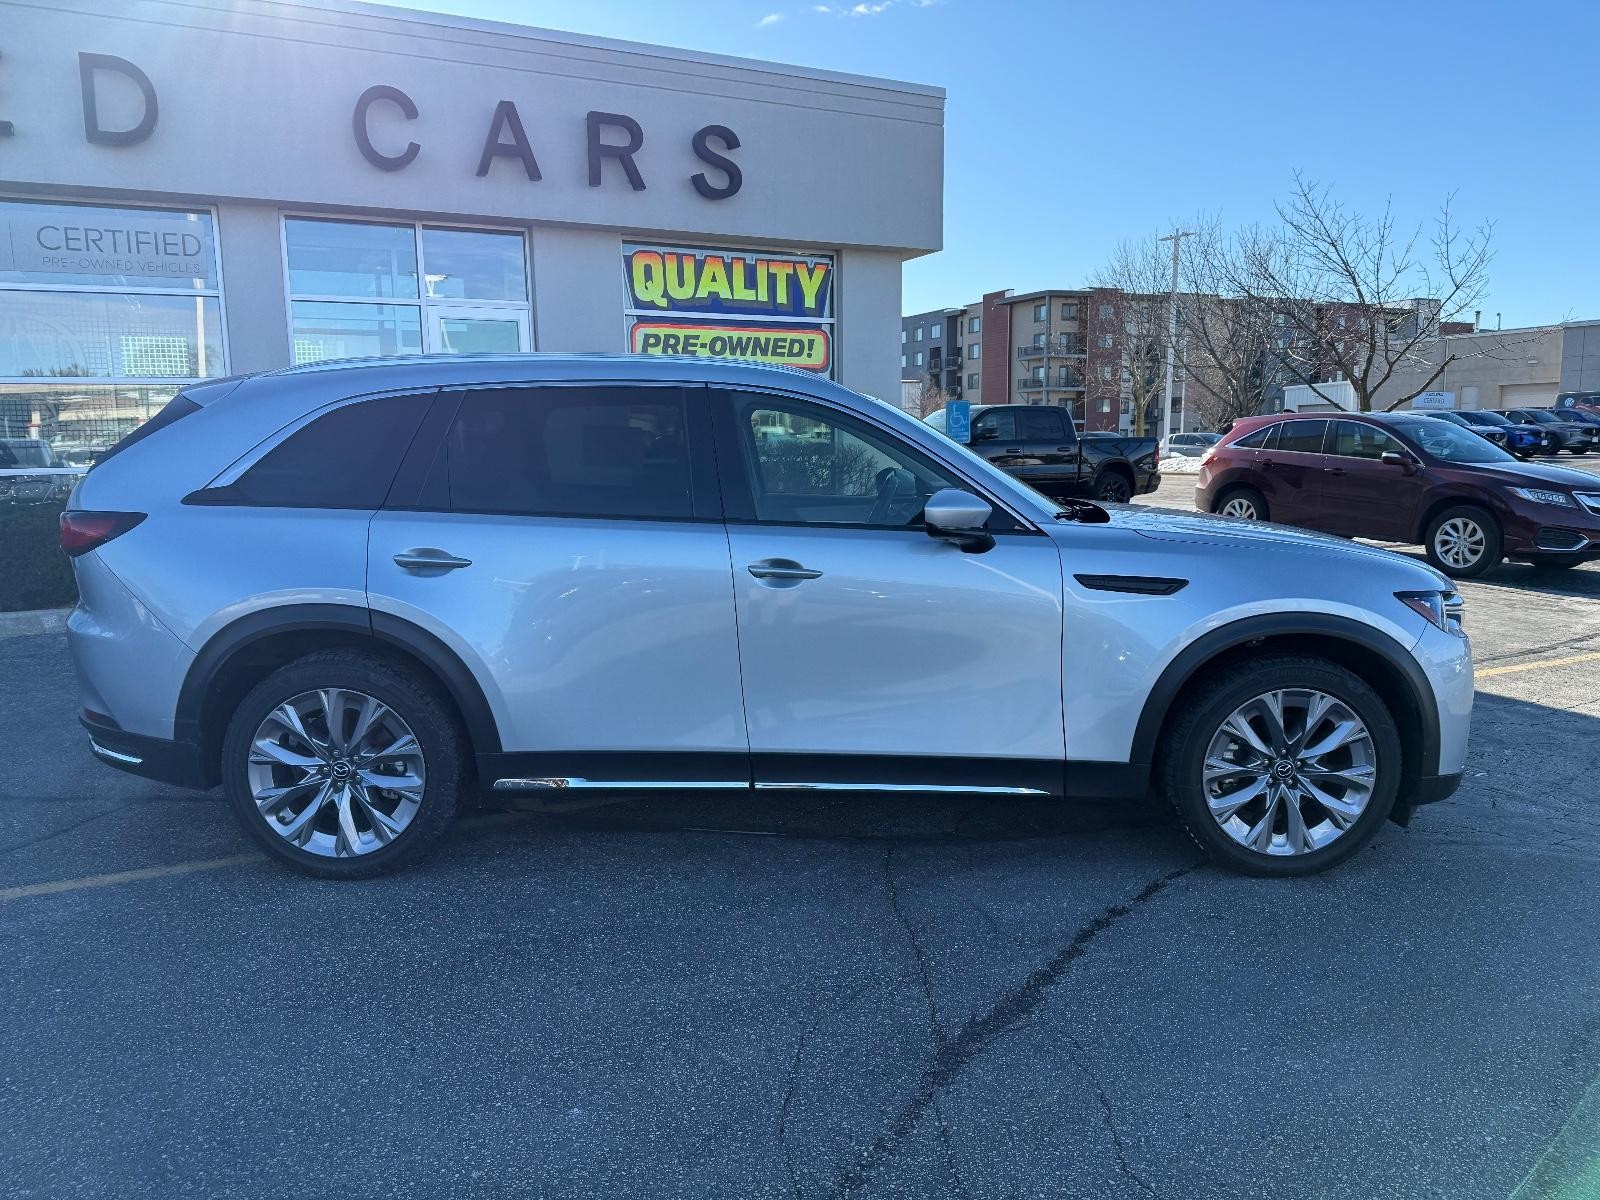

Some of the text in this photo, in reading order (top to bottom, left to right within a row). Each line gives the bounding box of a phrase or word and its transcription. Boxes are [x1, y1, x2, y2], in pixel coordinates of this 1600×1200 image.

[352, 84, 743, 200] CARS
[36, 225, 202, 257] CERTIFIED
[137, 260, 201, 274] VEHICLES
[632, 252, 828, 308] QUALITY
[641, 333, 815, 358] PRE-OWNED!
